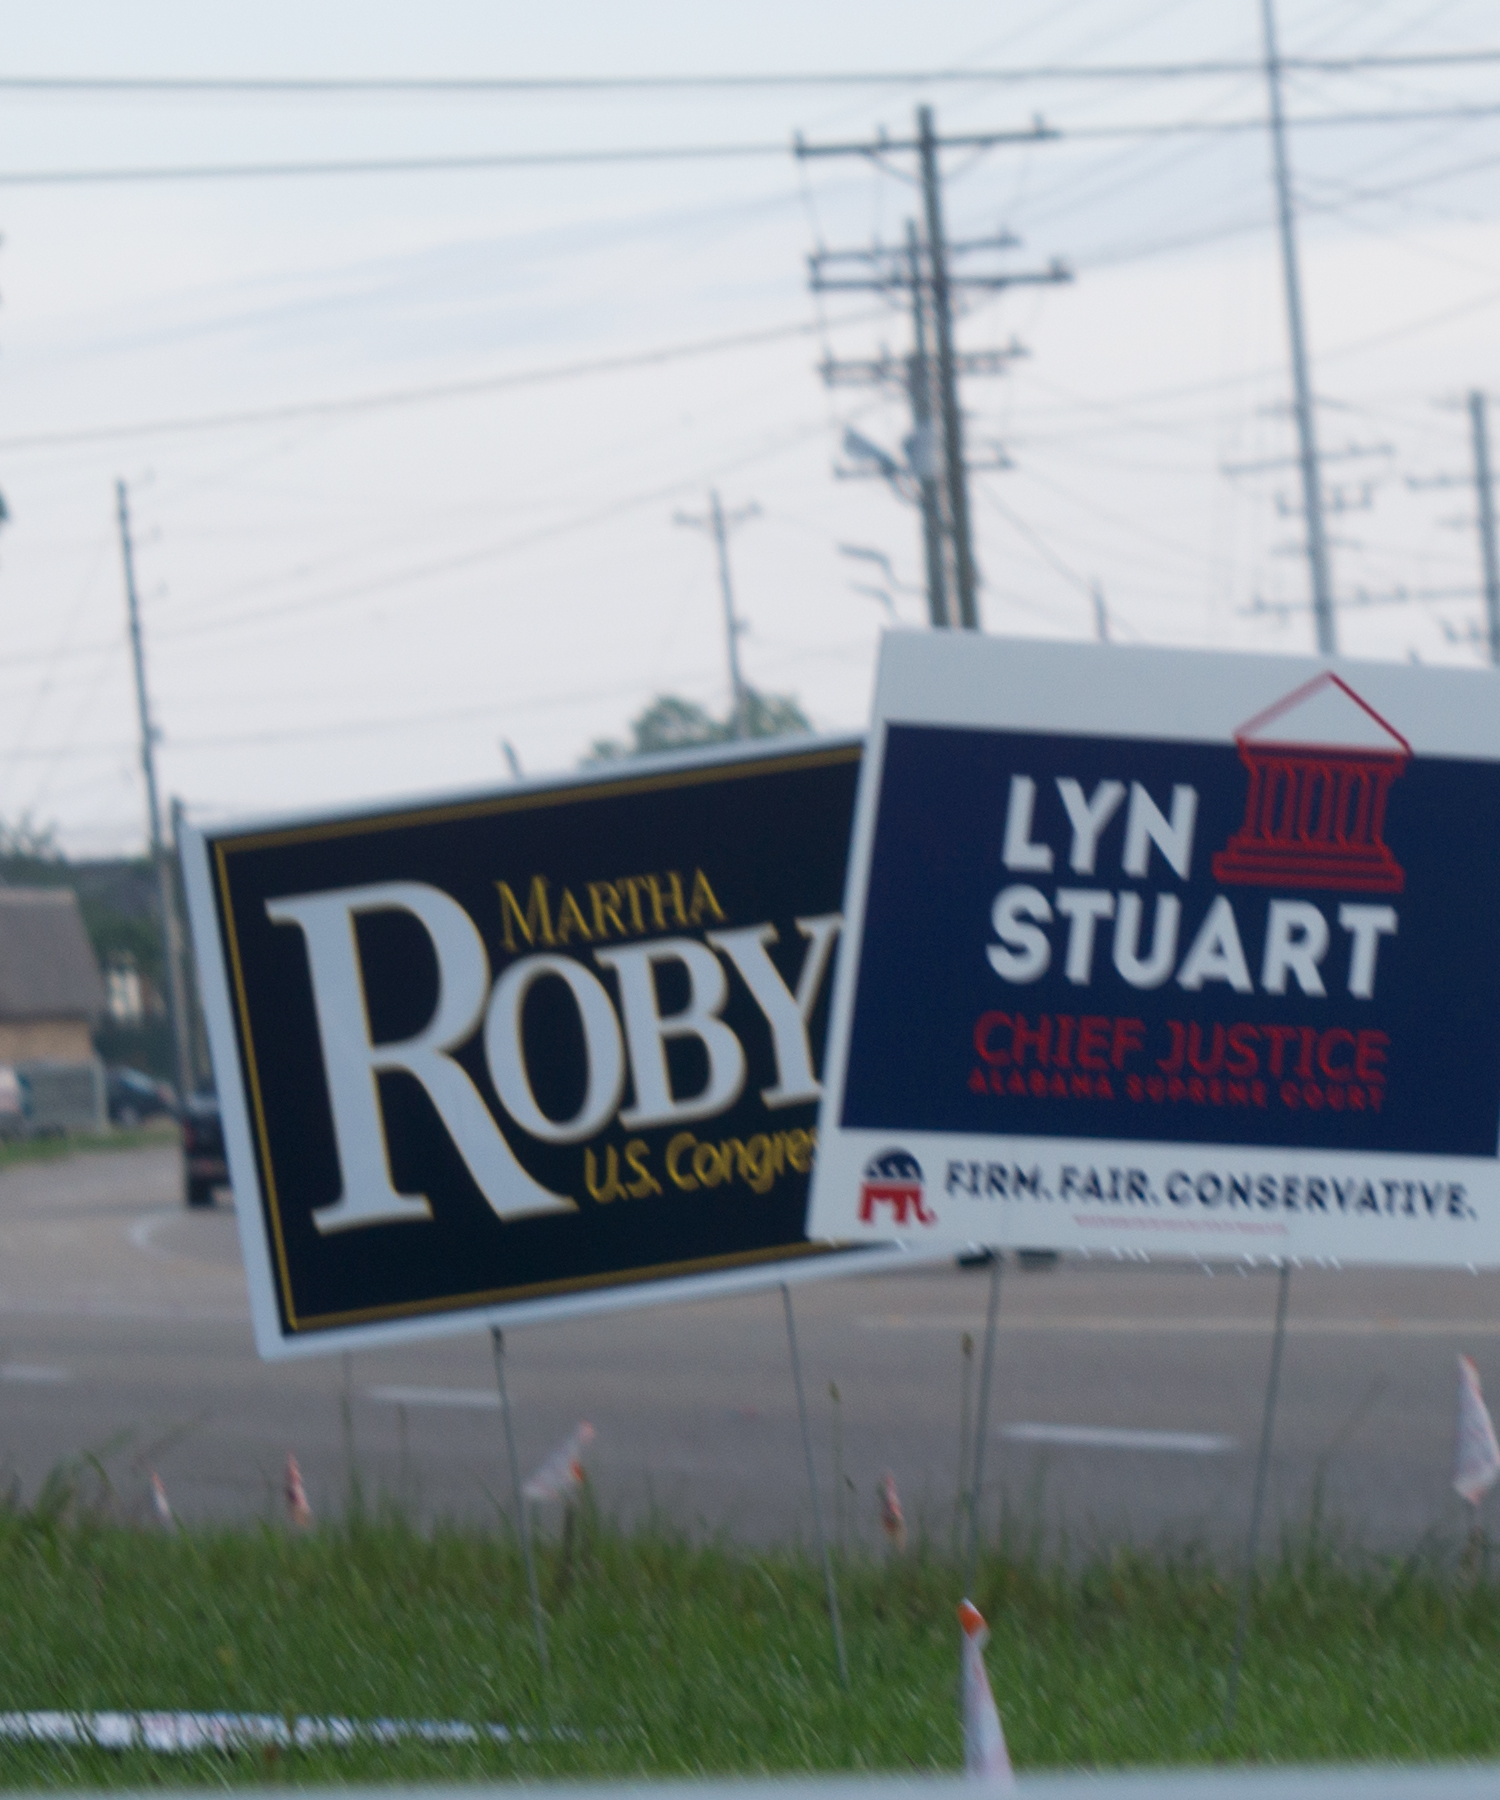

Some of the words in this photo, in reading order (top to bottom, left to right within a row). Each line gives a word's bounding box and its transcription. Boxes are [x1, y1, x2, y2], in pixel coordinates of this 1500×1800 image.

[1002, 773, 1199, 881] LYN
[494, 867, 727, 951] MARTHA
[986, 884, 1399, 1000] STUART
[263, 879, 847, 1236] ROBY
[972, 1008, 1147, 1071] CHIEF
[1157, 1018, 1391, 1085] JUSTICE
[583, 1137, 663, 1205] U.S.
[665, 1126, 818, 1194] Congre
